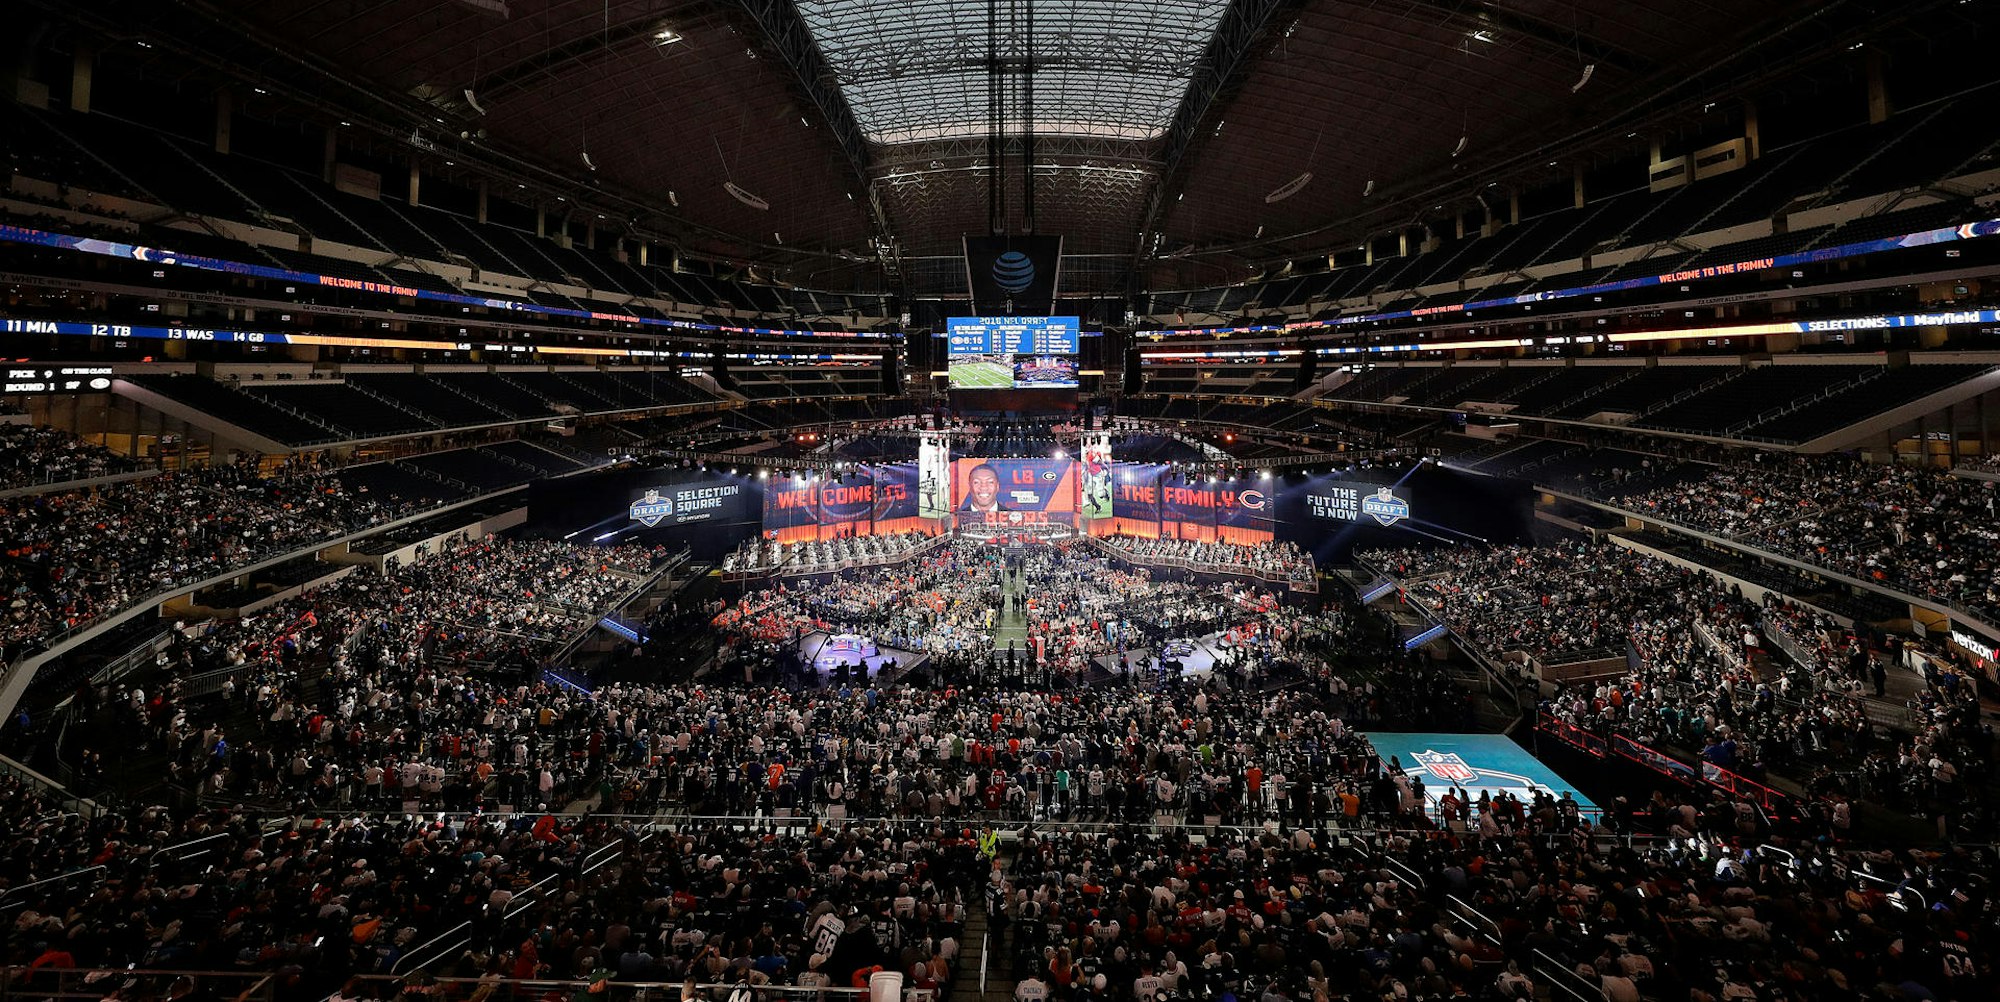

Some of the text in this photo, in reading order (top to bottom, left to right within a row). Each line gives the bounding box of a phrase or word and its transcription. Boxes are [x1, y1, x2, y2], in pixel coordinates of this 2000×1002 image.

[1659, 258, 1774, 283] WELCOME TO THE FAMILY
[319, 275, 418, 297] WELCOME TO THE FAMILY
[7, 320, 58, 334] 11 MIA
[1003, 316, 1020, 325] NFL
[1021, 316, 1048, 325] DRAFT
[1808, 317, 1891, 332] SELECTIONS:
[1898, 315, 1905, 327] 1
[1913, 310, 1980, 327] Mayfield
[91, 324, 131, 336] 12 TB
[167, 328, 215, 341] 13 WAS
[232, 331, 265, 343] 14 GB
[9, 370, 53, 378] PICK 9
[5, 383, 45, 392] ROUND
[1012, 469, 1035, 484] LB
[677, 484, 739, 502] SELECTION
[777, 483, 906, 509] WELCOME TO
[1121, 485, 1236, 508] THE FAMILY
[1331, 487, 1358, 500] THE
[633, 504, 670, 516] DRAFT
[677, 497, 723, 513] SQUARE
[1306, 495, 1358, 511] FUTURE
[1366, 503, 1405, 515] DRAFT
[1312, 506, 1358, 521] IS NOW
[1951, 629, 1995, 663] verizon
[1427, 763, 1472, 780] NFL
[815, 928, 838, 959] 88
